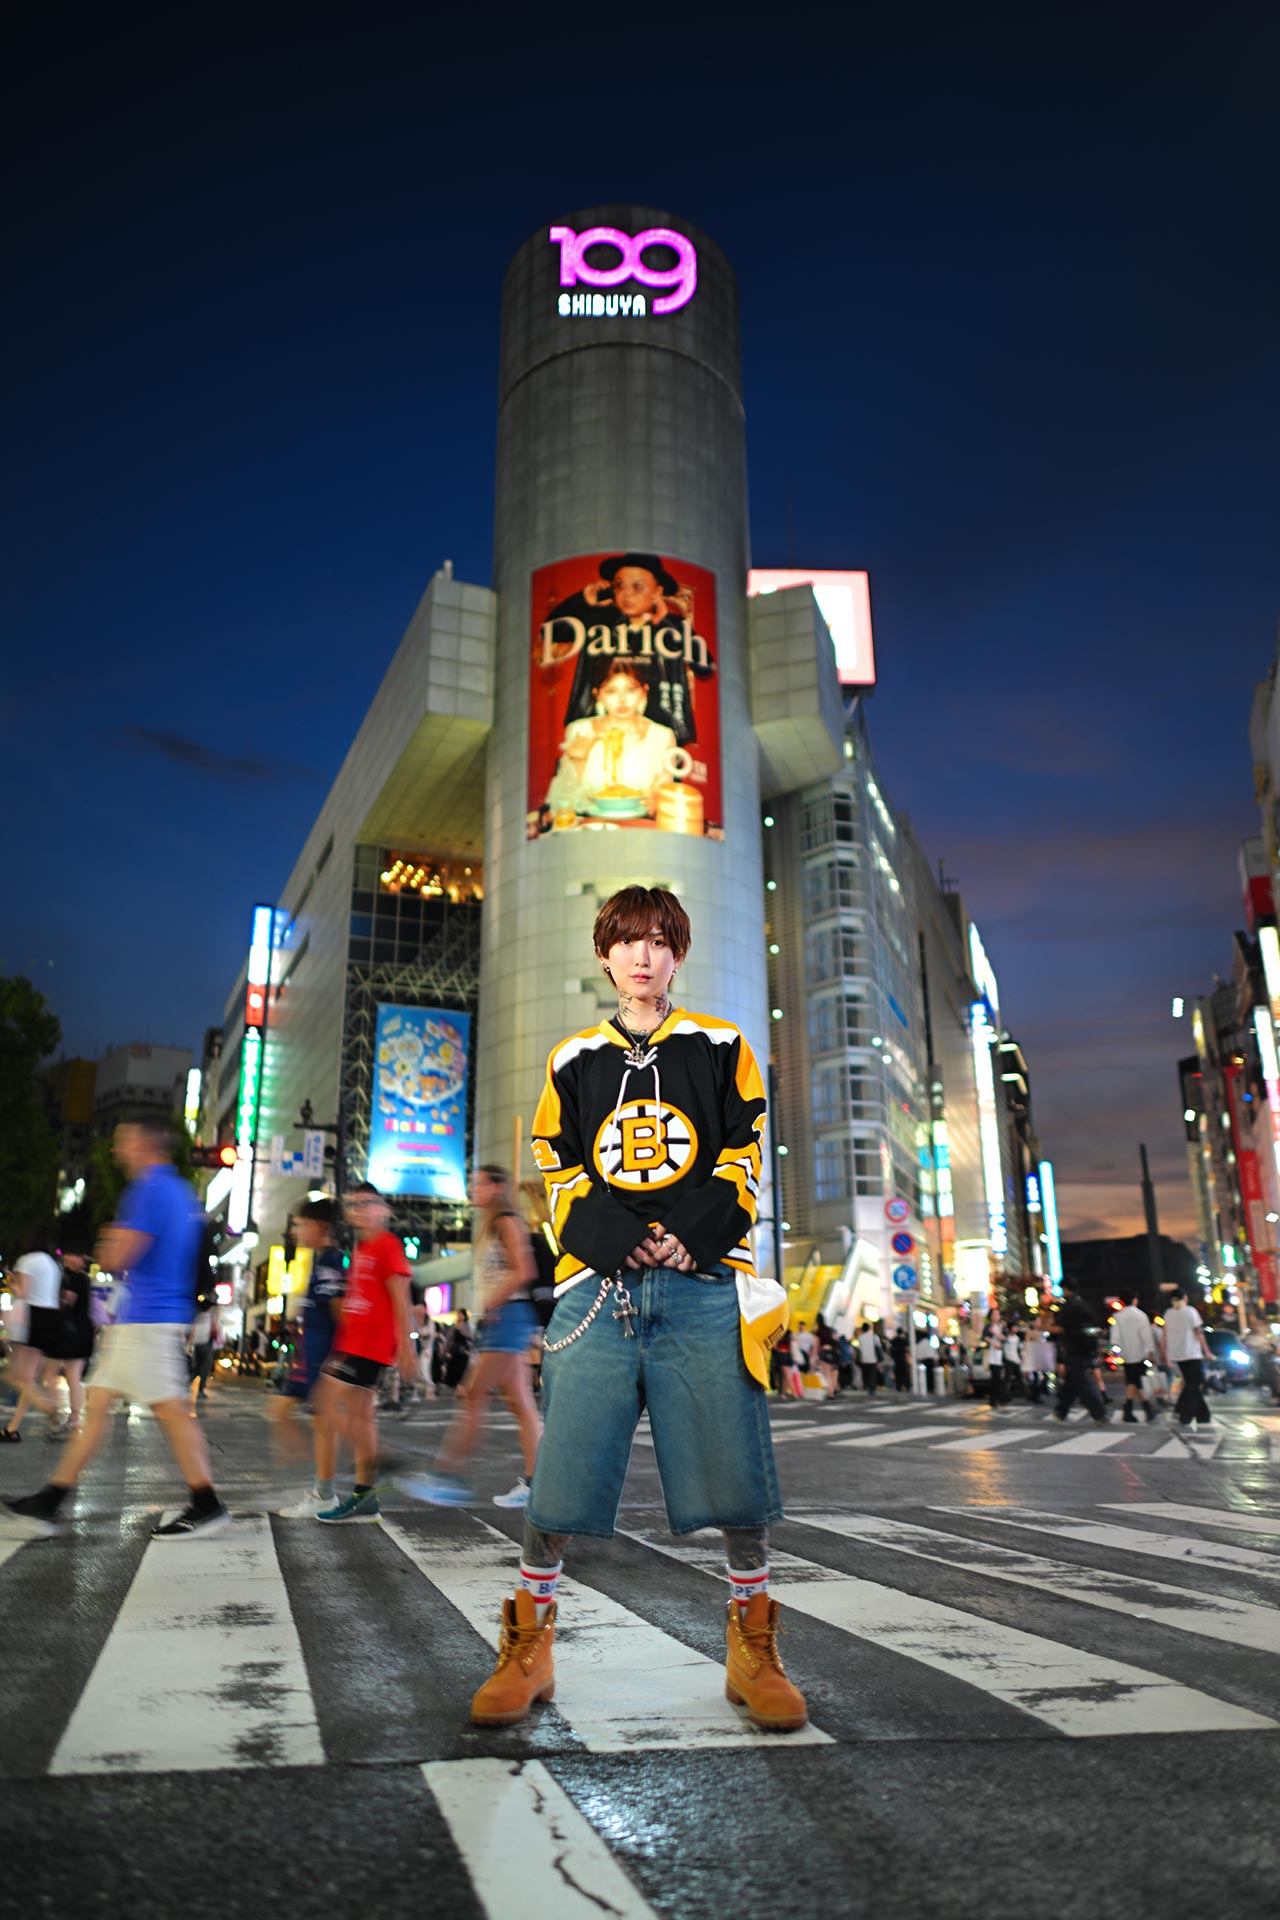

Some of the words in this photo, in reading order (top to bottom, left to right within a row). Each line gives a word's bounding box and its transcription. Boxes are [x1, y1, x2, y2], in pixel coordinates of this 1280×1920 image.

[550, 226, 697, 314] 109
[558, 294, 646, 316] SHIBUYA
[539, 616, 709, 668] Darich
[622, 1116, 668, 1171] B
